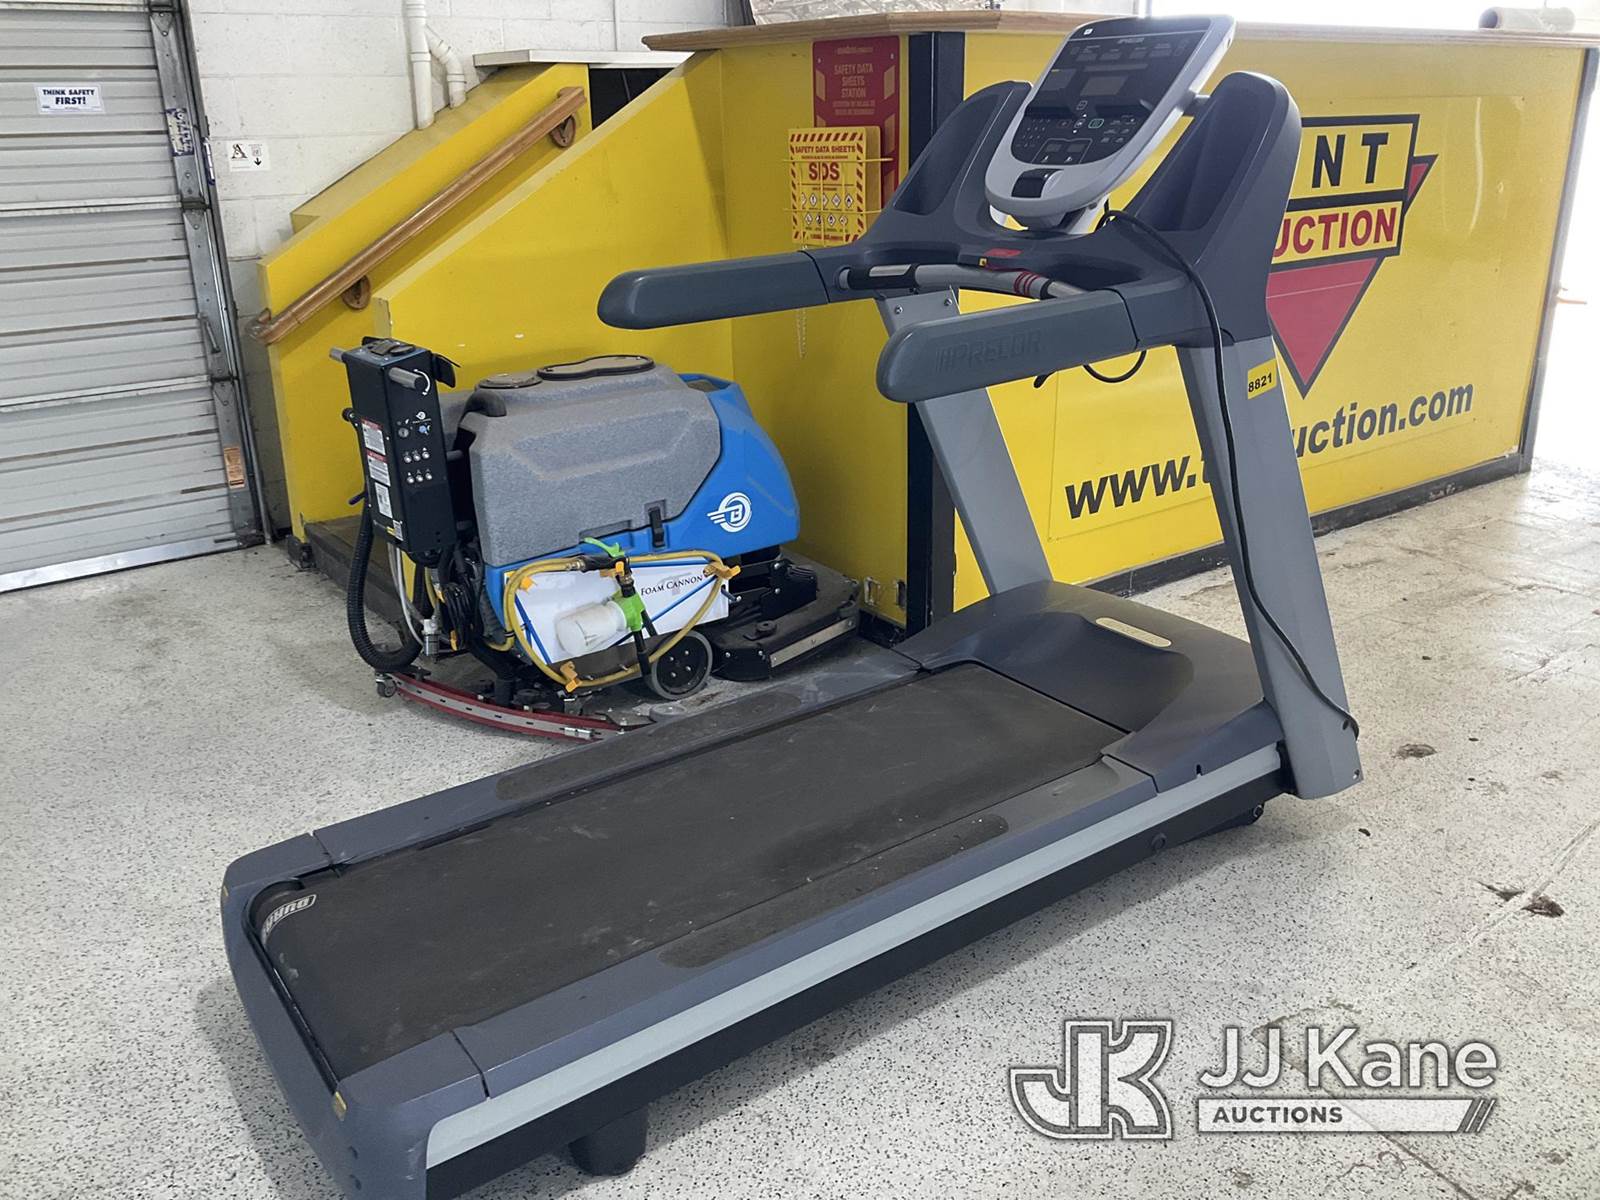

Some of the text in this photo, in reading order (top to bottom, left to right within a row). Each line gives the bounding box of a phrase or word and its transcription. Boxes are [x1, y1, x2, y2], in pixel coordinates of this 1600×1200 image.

[834, 63, 874, 75] SAFETY DATA
[842, 75, 865, 87] SHEETS
[55, 96, 86, 105] FIRST!
[841, 87, 867, 98] STATION
[795, 145, 856, 154] SAFETY DATA SHEETS
[1311, 132, 1390, 188] NT
[808, 161, 840, 181] SDS
[1274, 206, 1398, 258] UCTION
[1248, 372, 1272, 392] 8821
[641, 575, 703, 597] FOAM CANNON
